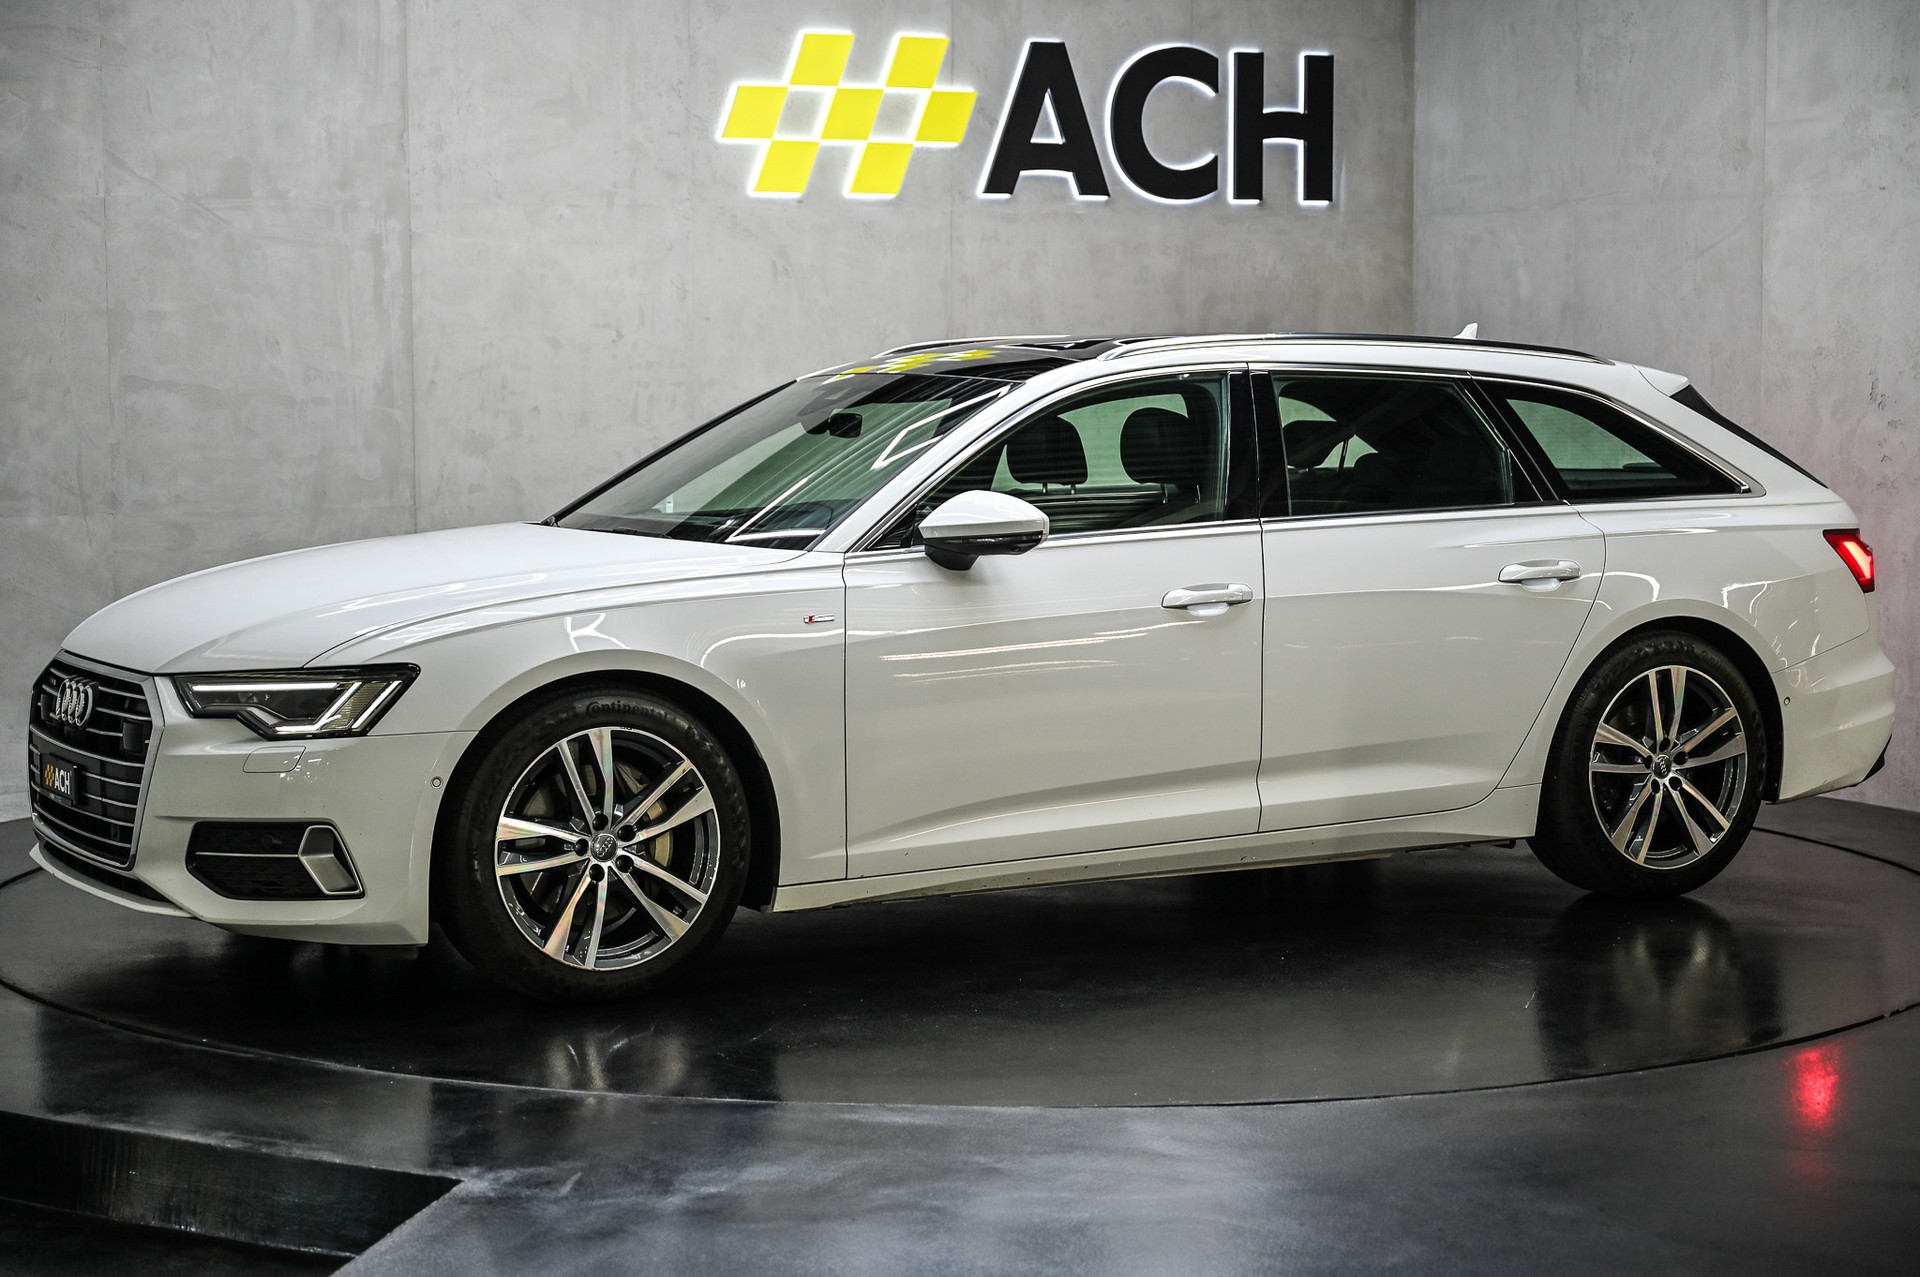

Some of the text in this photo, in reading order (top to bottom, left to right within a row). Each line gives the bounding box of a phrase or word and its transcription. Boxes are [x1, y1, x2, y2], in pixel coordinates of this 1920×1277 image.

[981, 41, 1334, 203] ACH
[586, 700, 668, 719] Continental
[54, 766, 70, 795] ACH
